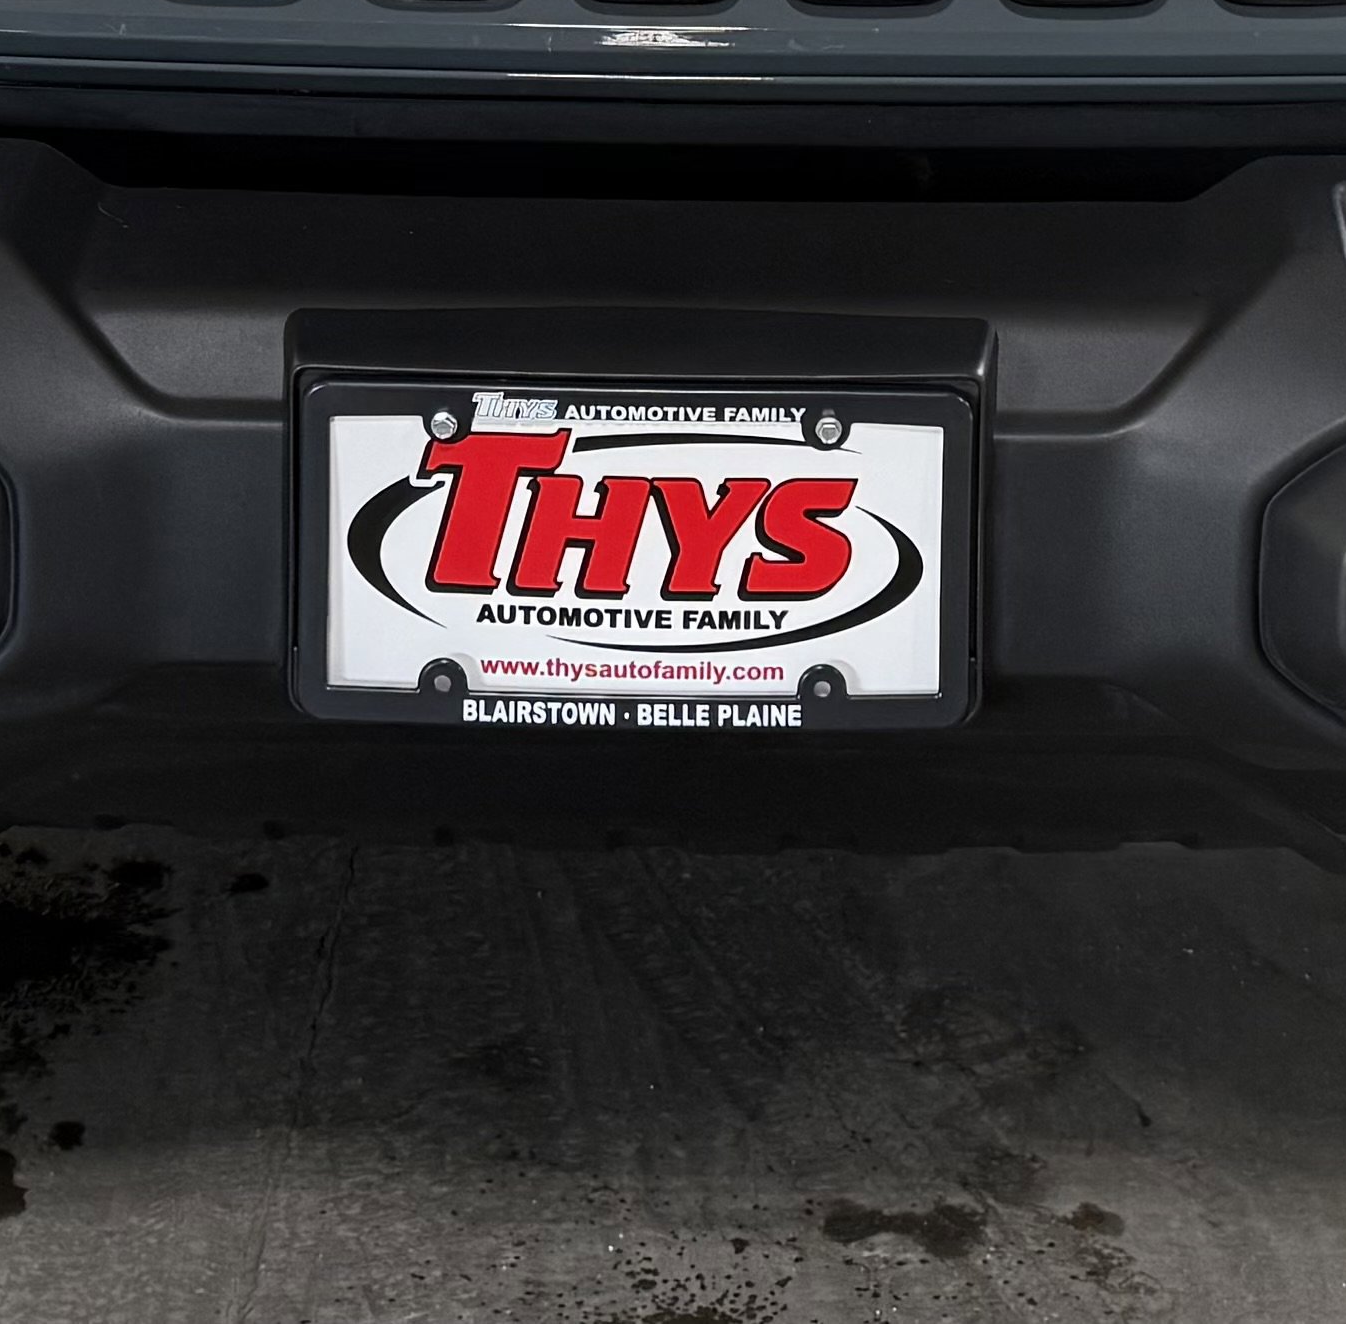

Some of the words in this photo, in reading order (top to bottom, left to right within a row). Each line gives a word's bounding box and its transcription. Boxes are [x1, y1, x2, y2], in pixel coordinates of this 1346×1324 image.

[472, 392, 558, 421] THYS
[565, 405, 717, 423] AUTOMOTIVE
[722, 406, 807, 425] FAMILY
[418, 428, 858, 602] THYS
[476, 604, 673, 631] AUTOMOTIVE
[681, 608, 789, 632] FAMILY
[480, 656, 785, 685] www.thysautofamily.com
[462, 698, 617, 726] BLAIRSTOWN
[636, 701, 713, 727] BELLE
[718, 702, 803, 728] PLAINE
